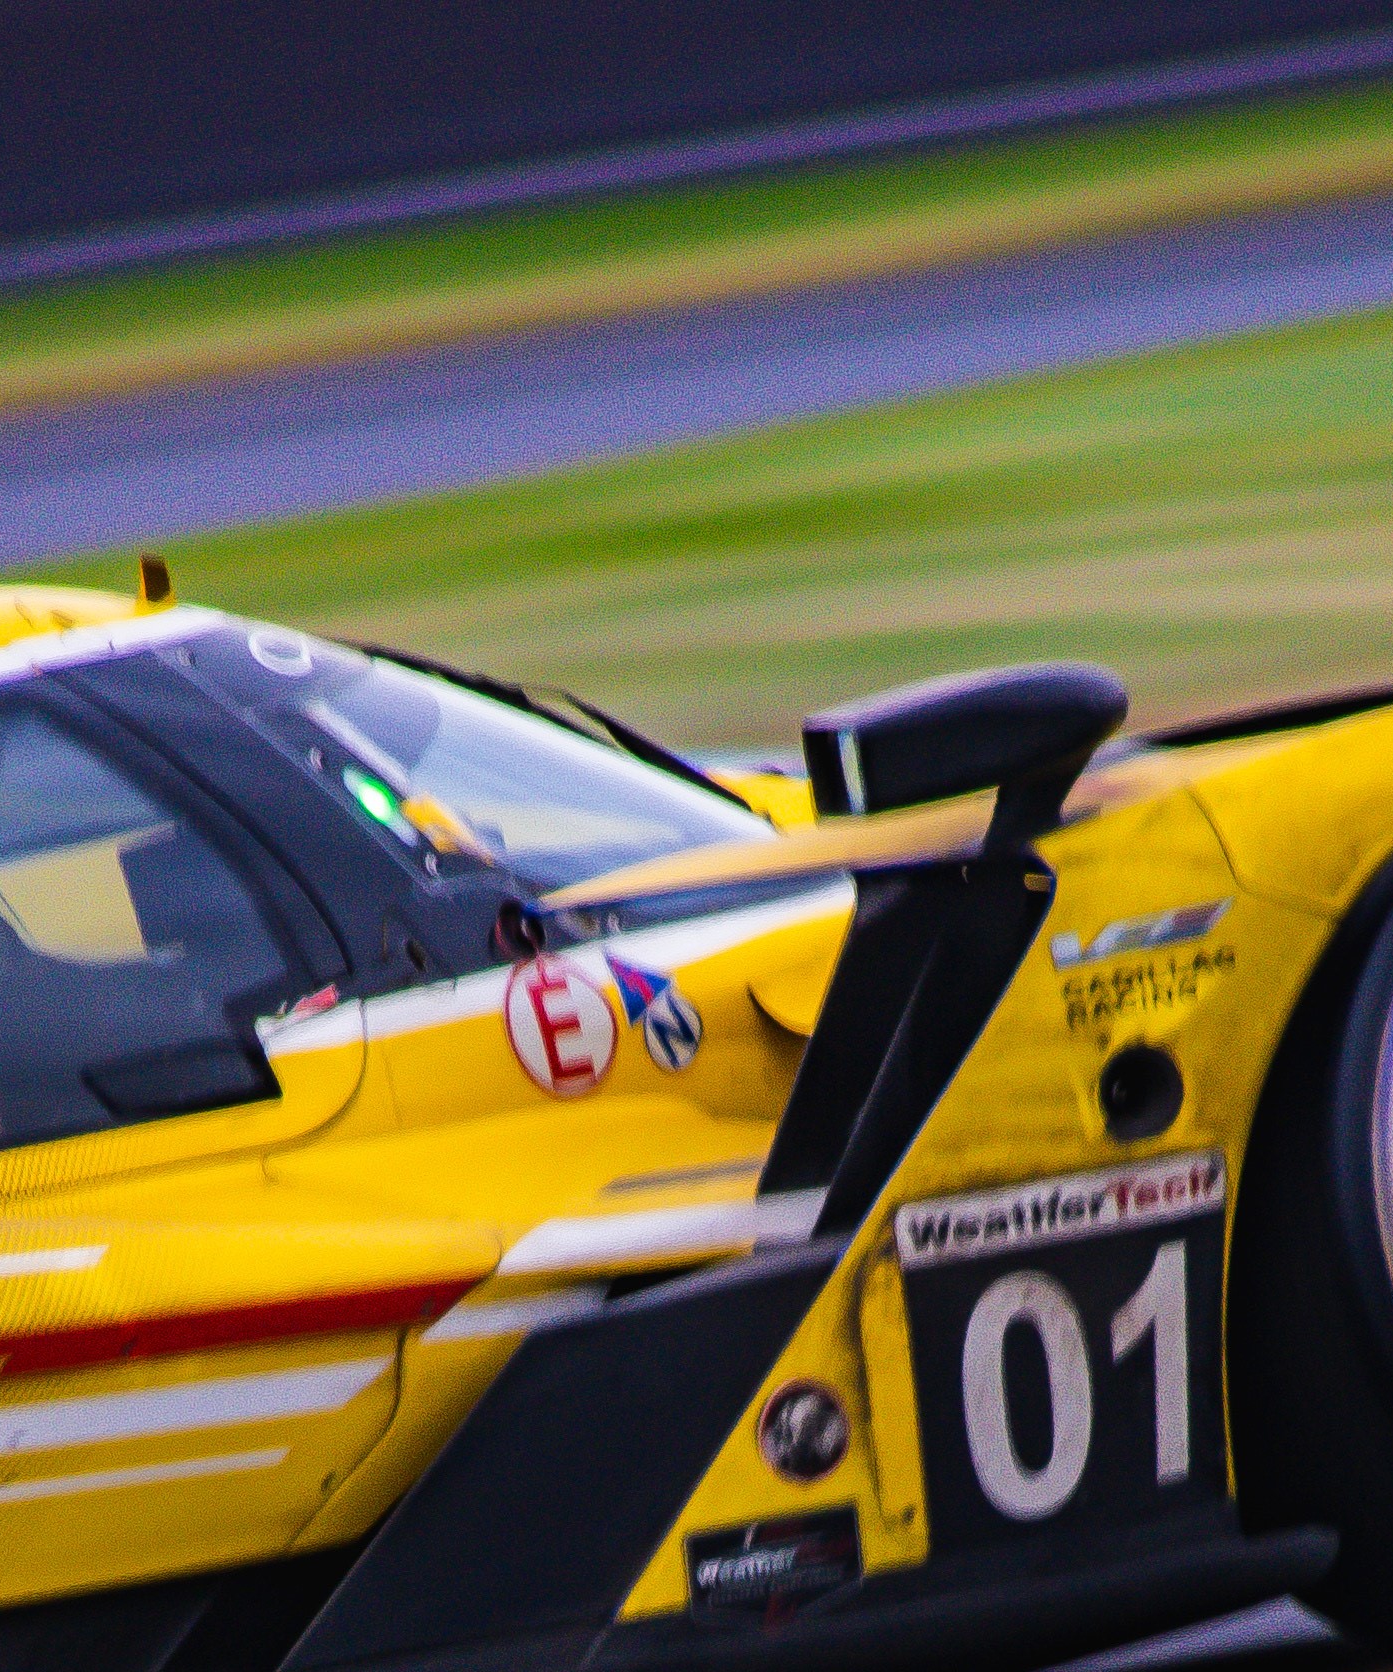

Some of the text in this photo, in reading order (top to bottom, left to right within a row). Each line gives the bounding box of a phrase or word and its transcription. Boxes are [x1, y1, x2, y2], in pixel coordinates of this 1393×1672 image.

[526, 975, 595, 1082] E
[908, 1156, 1223, 1252] WeatherTech
[962, 1239, 1190, 1523] 01
